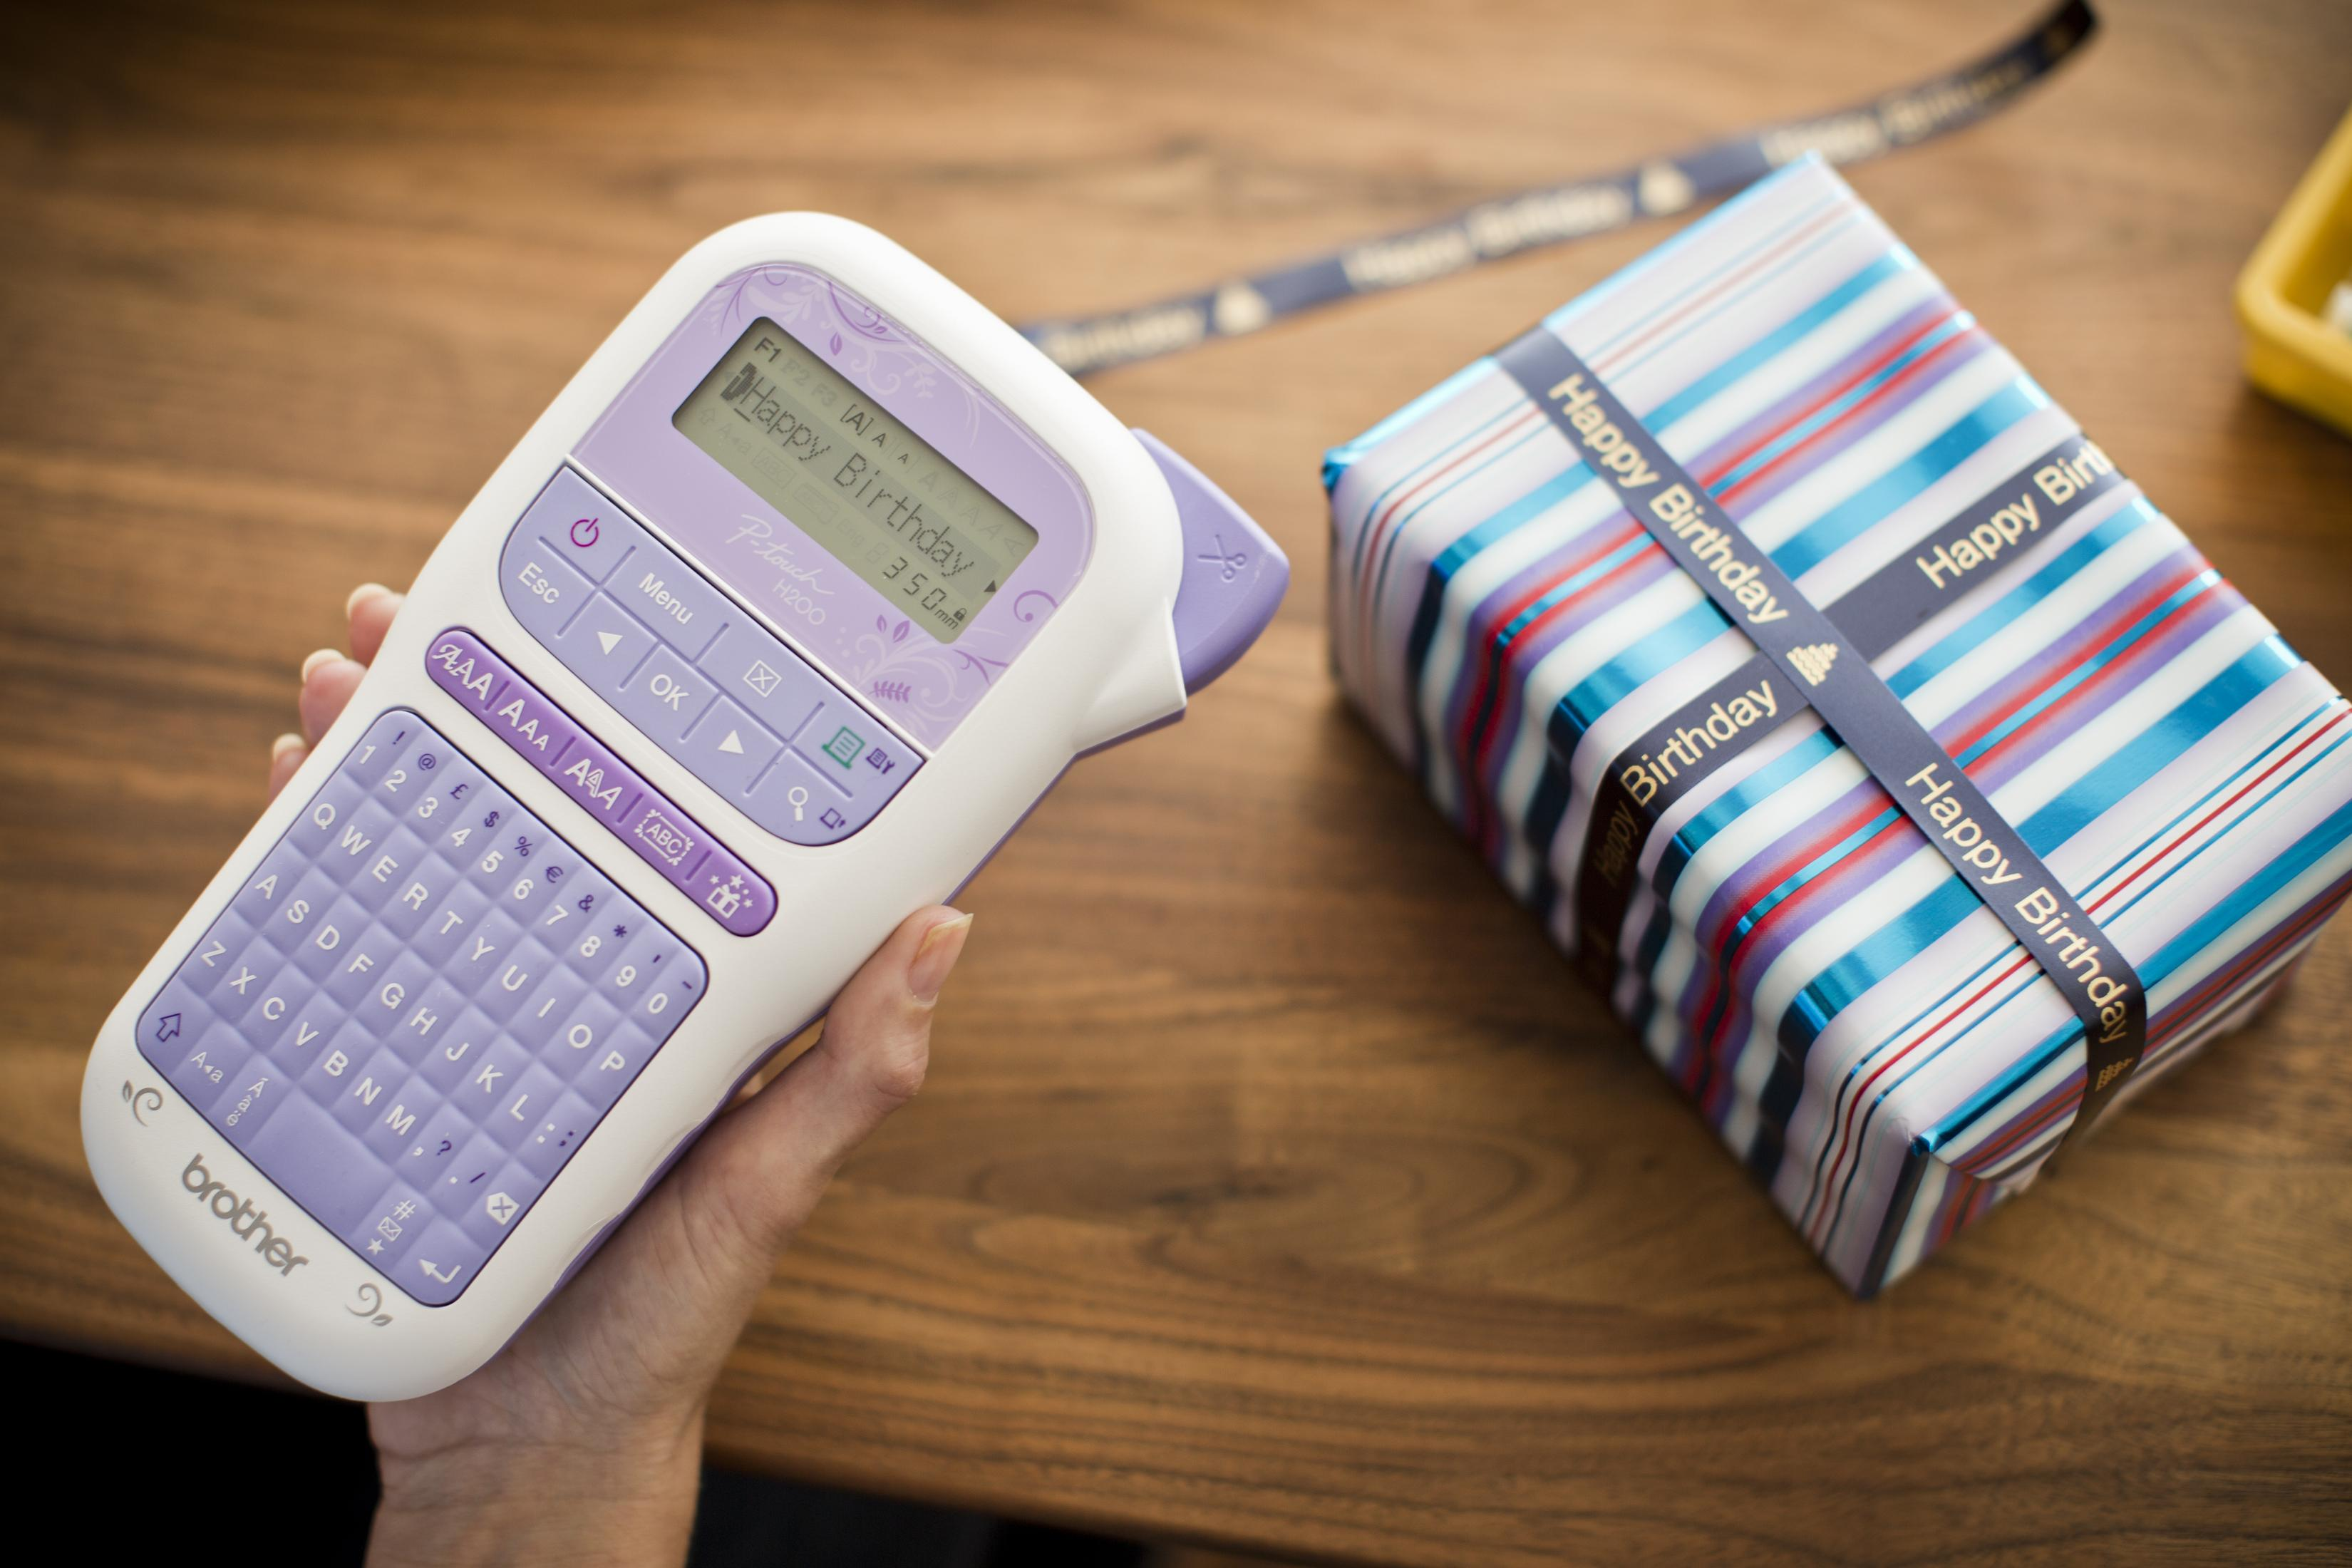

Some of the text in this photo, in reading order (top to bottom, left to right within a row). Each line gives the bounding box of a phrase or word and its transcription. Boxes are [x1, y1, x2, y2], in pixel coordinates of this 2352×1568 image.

[753, 336, 783, 363] F1
[738, 376, 974, 578] Happy Birthday
[1548, 373, 1789, 624] Happy Birthday
[517, 561, 561, 605] Esc
[639, 572, 694, 626] Menu
[772, 579, 826, 626] H200
[1916, 492, 2041, 589] Happy
[650, 672, 690, 711] OK
[1619, 679, 1779, 808] Birthday
[359, 745, 376, 765] 1
[385, 770, 406, 792] 2
[418, 797, 438, 818] 3
[450, 827, 472, 847] 4
[481, 850, 504, 873] 5
[513, 879, 534, 899] 6
[545, 904, 569, 926] 7
[579, 935, 602, 957] 8
[616, 965, 636, 987] 9
[646, 822, 683, 854] ABC
[314, 803, 336, 830] Q
[341, 825, 371, 856] W
[371, 855, 398, 882] E
[403, 882, 428, 911] R
[440, 910, 463, 935] T
[471, 937, 495, 961] Y
[502, 964, 528, 991] U
[568, 1023, 593, 1049] O
[599, 1050, 626, 1071] P
[1905, 763, 2128, 1043] Happy Birthday
[201, 940, 227, 967] Z
[229, 966, 257, 995] X
[262, 997, 285, 1021] C
[295, 1021, 319, 1047] V
[324, 1049, 349, 1077] B
[354, 1077, 383, 1106] N
[385, 1104, 416, 1136] M
[254, 874, 278, 899] A
[287, 899, 309, 924] S
[316, 924, 340, 950] D
[348, 954, 374, 974] F
[381, 982, 405, 1010] G
[410, 1006, 438, 1036] H
[445, 1042, 470, 1061] J
[475, 1064, 504, 1094] K
[510, 1094, 529, 1122] L
[181, 1152, 309, 1276] brother
